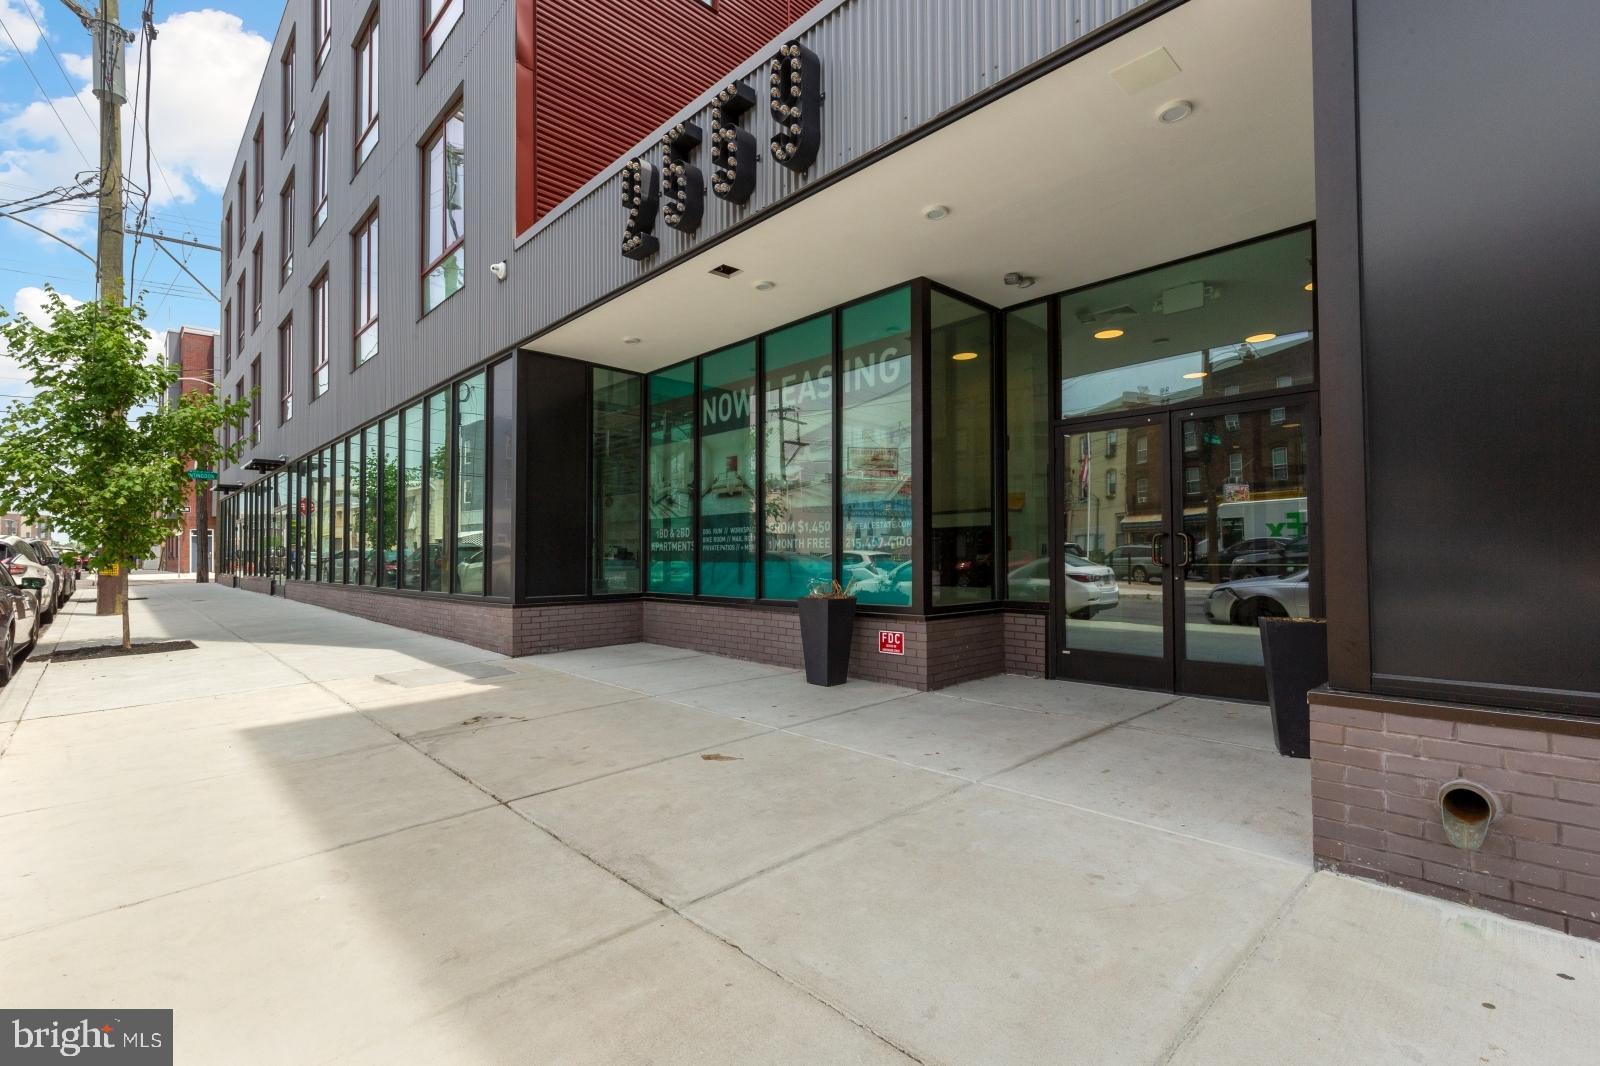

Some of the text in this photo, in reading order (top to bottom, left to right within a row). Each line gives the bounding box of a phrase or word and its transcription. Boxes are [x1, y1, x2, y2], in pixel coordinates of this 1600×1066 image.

[621, 40, 820, 260] 2559
[703, 347, 901, 427] NOW LEASING
[797, 519, 831, 534] $1,450
[651, 541, 695, 552] APARTMENTS
[774, 538, 805, 549] MONTH
[807, 537, 831, 549] FREE
[881, 632, 901, 644] FDC
